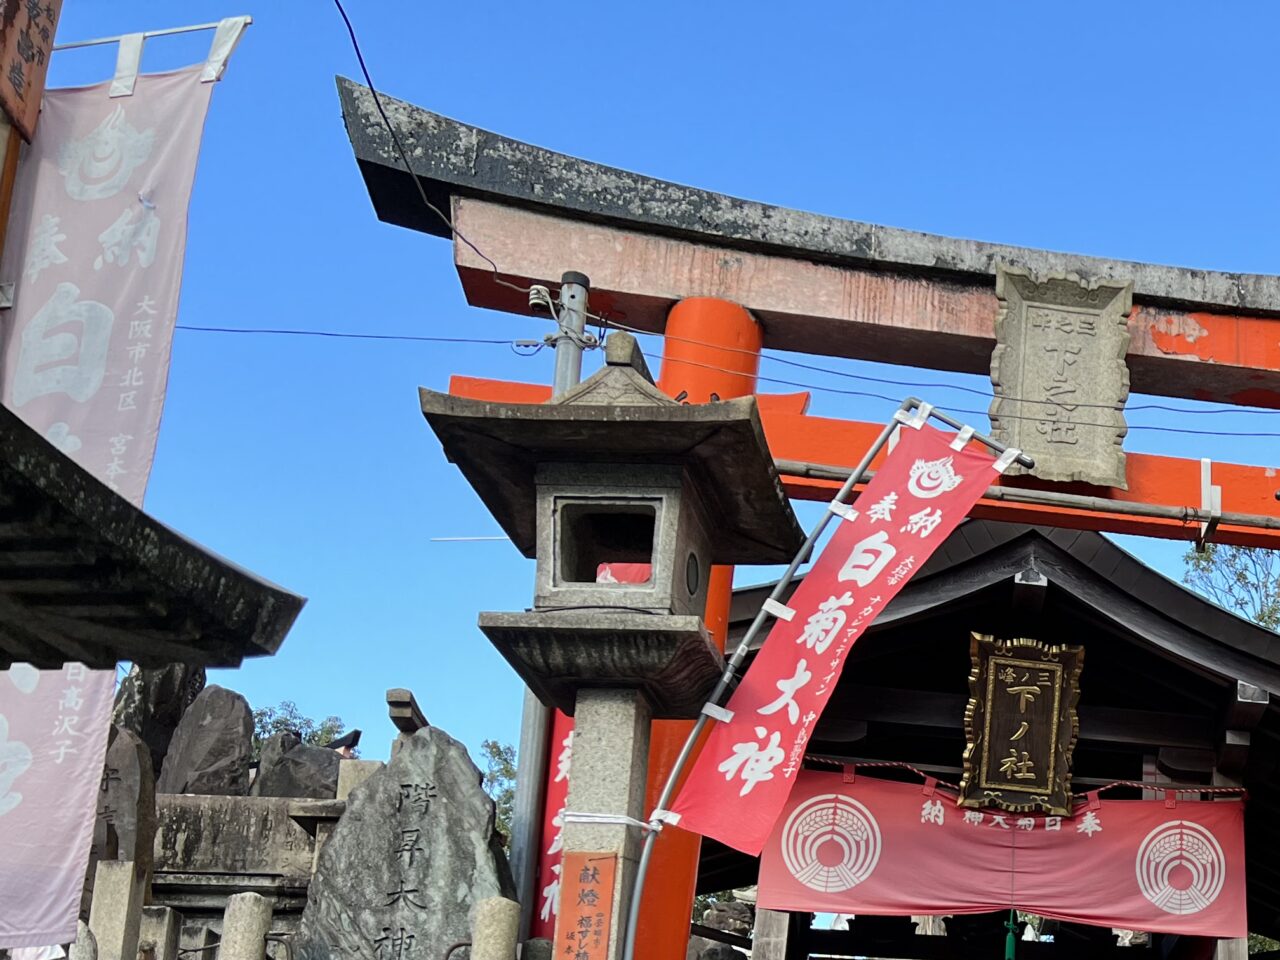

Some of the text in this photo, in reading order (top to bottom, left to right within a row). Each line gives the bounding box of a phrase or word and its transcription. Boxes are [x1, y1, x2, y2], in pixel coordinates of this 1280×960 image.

[13, 282, 114, 451] 白
[118, 294, 157, 412] 大阪市北区
[104, 433, 134, 491] 宮本
[865, 491, 942, 538] 奉納
[718, 530, 896, 797] 白菊大神
[1000, 685, 1041, 780] 下ノ社
[920, 799, 945, 826] 納
[1077, 811, 1102, 837] 奉
[577, 865, 601, 907] 献燈
